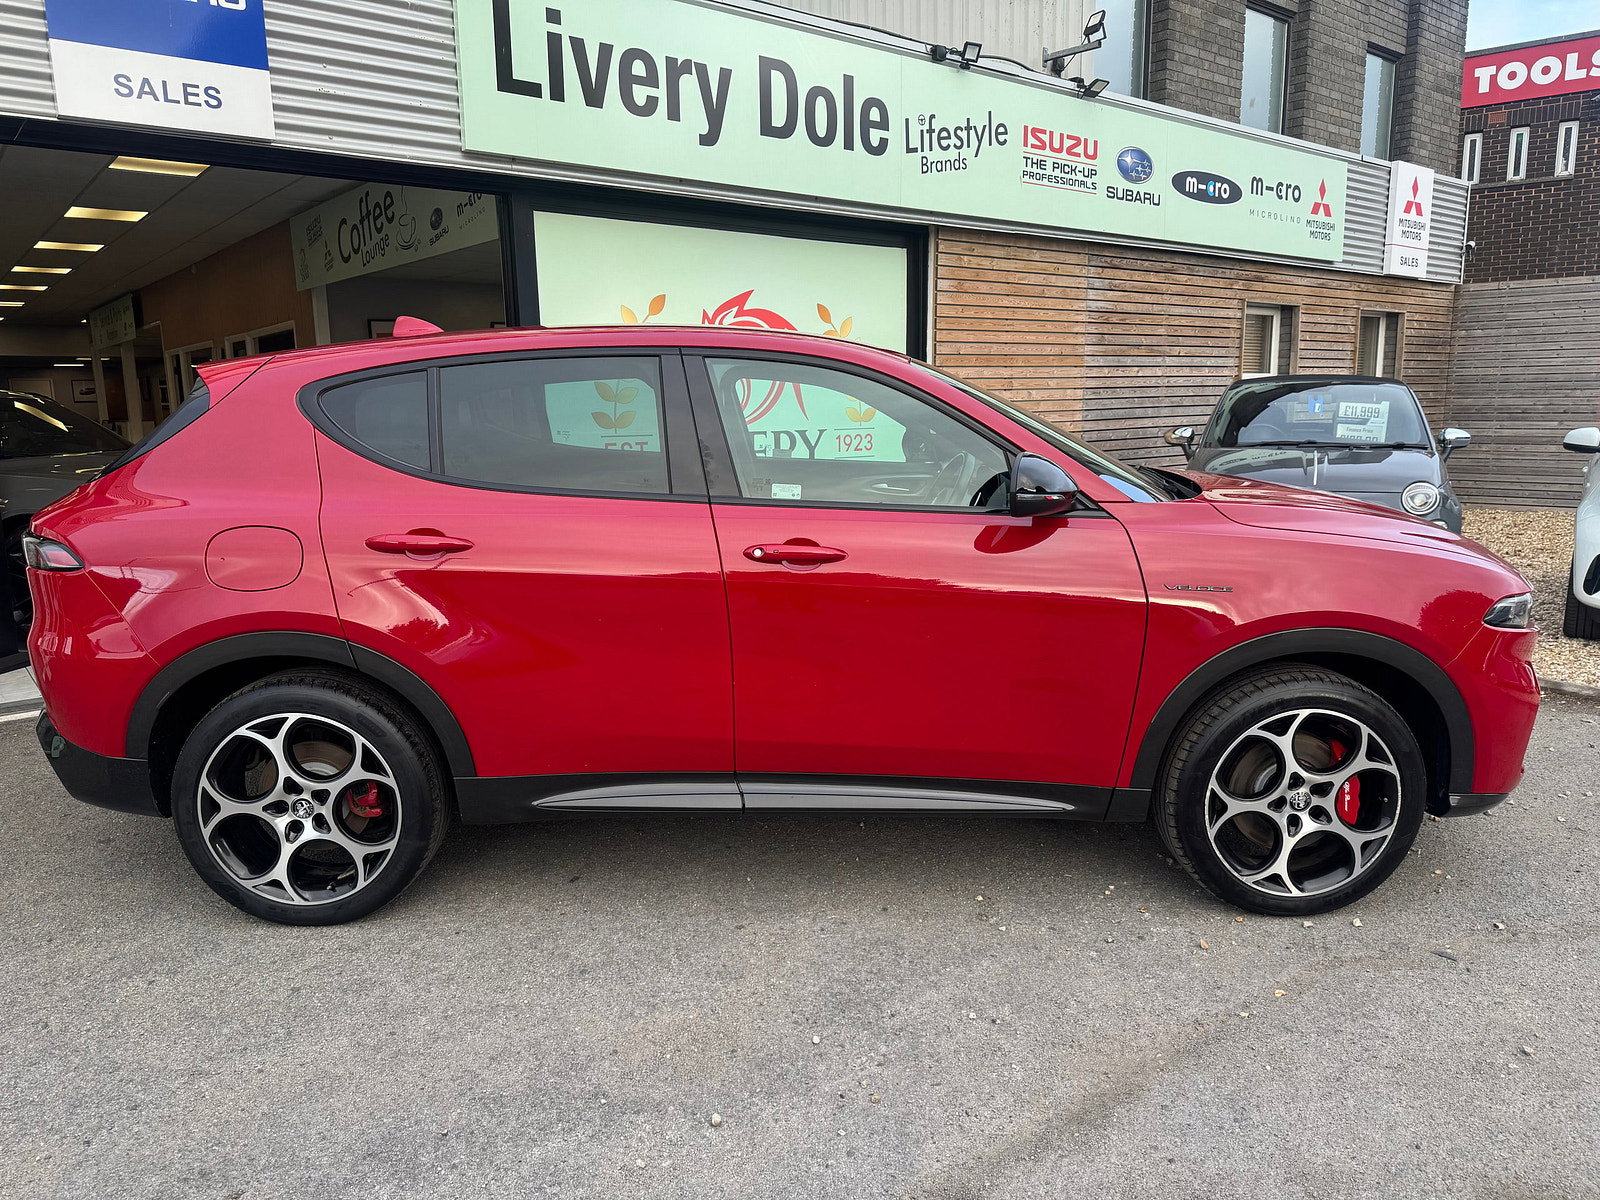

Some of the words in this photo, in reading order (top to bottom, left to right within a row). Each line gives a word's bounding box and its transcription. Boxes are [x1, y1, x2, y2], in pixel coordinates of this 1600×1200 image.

[491, 0, 733, 147] Livery
[758, 55, 890, 157] Dole
[113, 73, 223, 110] SALES
[904, 110, 1009, 158] Lifestyle
[1022, 125, 1099, 161] ISUZU
[920, 152, 968, 175] Brands
[1022, 156, 1047, 171] THE
[1052, 161, 1098, 179] PICK-UP
[1022, 170, 1098, 191] PROFESSIONALS
[1106, 185, 1162, 207] SUBARU
[337, 190, 396, 264] Coffee
[1249, 208, 1301, 224] MICROLINO
[1306, 219, 1336, 233] MITSUBISHI
[1398, 218, 1427, 232] MITSUBISHI
[428, 225, 450, 247] SUBARU
[1309, 230, 1332, 242] MOTORS
[1401, 229, 1422, 241] MOTORS
[361, 233, 390, 268] Lounge
[1400, 255, 1419, 268] SALES
[1343, 404, 1380, 419] £11,999
[835, 433, 874, 453] 1923
